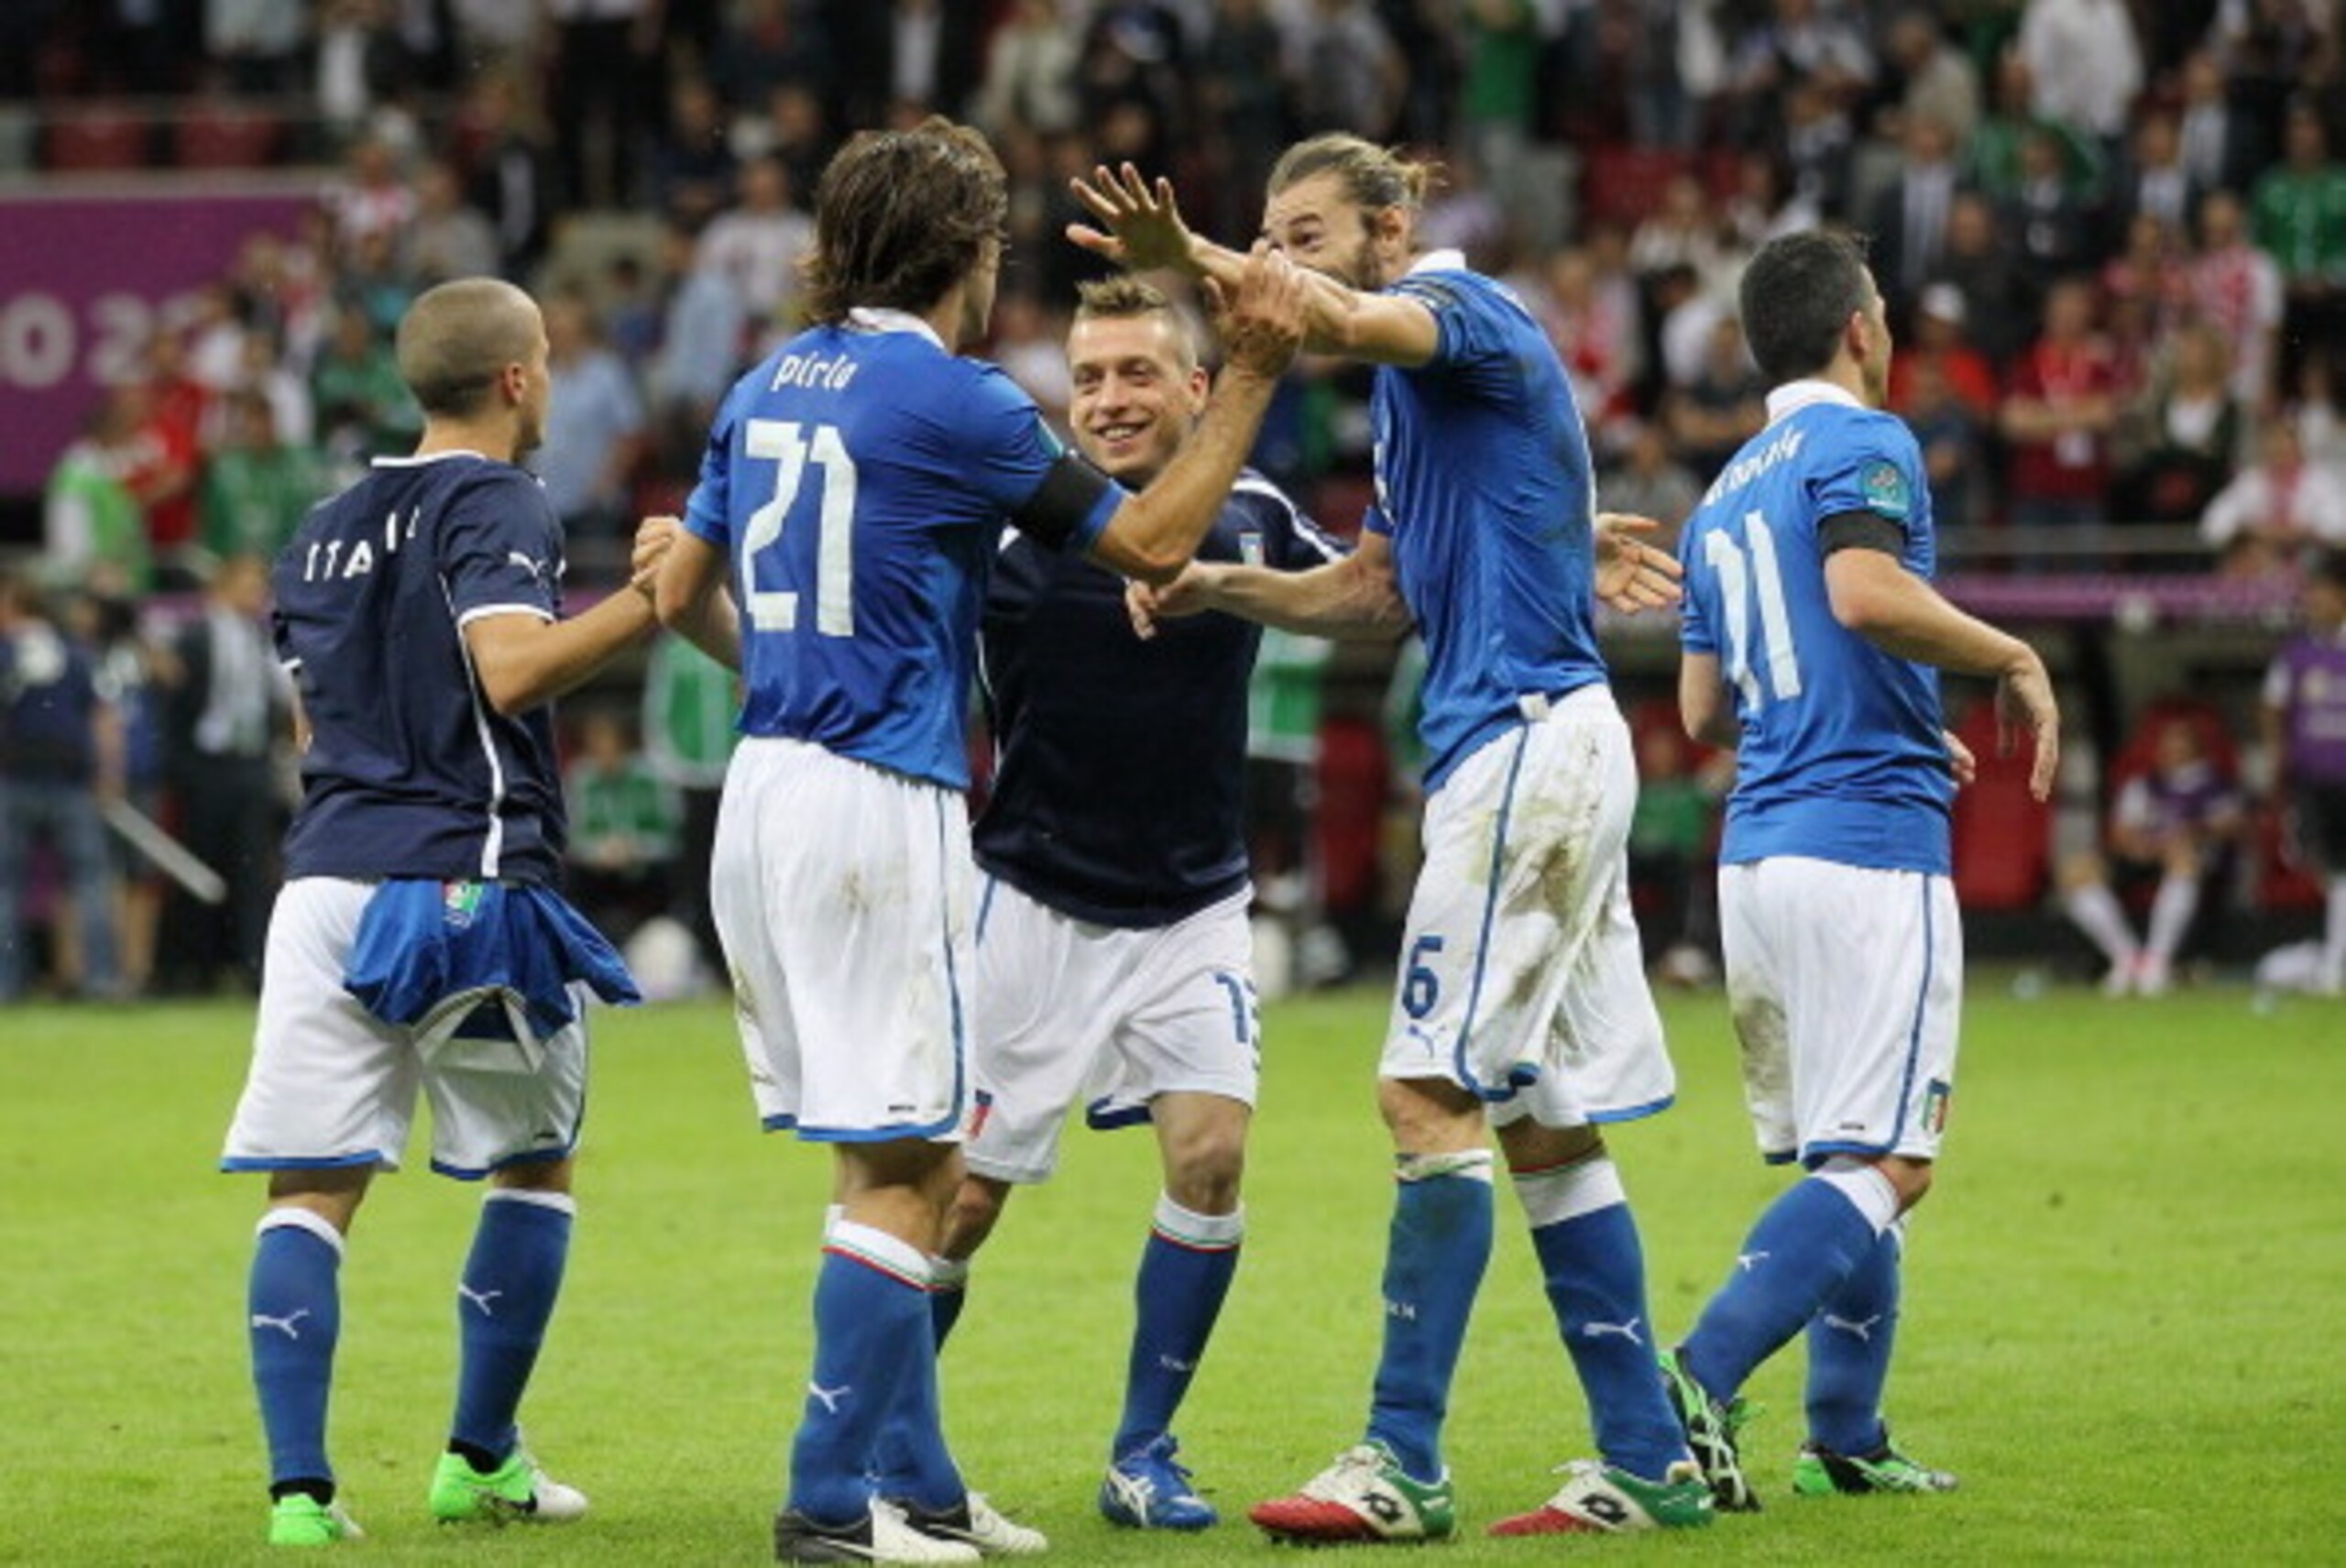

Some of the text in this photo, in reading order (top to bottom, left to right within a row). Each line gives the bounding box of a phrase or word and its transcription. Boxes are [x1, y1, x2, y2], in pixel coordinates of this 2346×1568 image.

[741, 418, 858, 638] 21
[1705, 509, 1802, 719] 11
[1401, 935, 1443, 1020] 6
